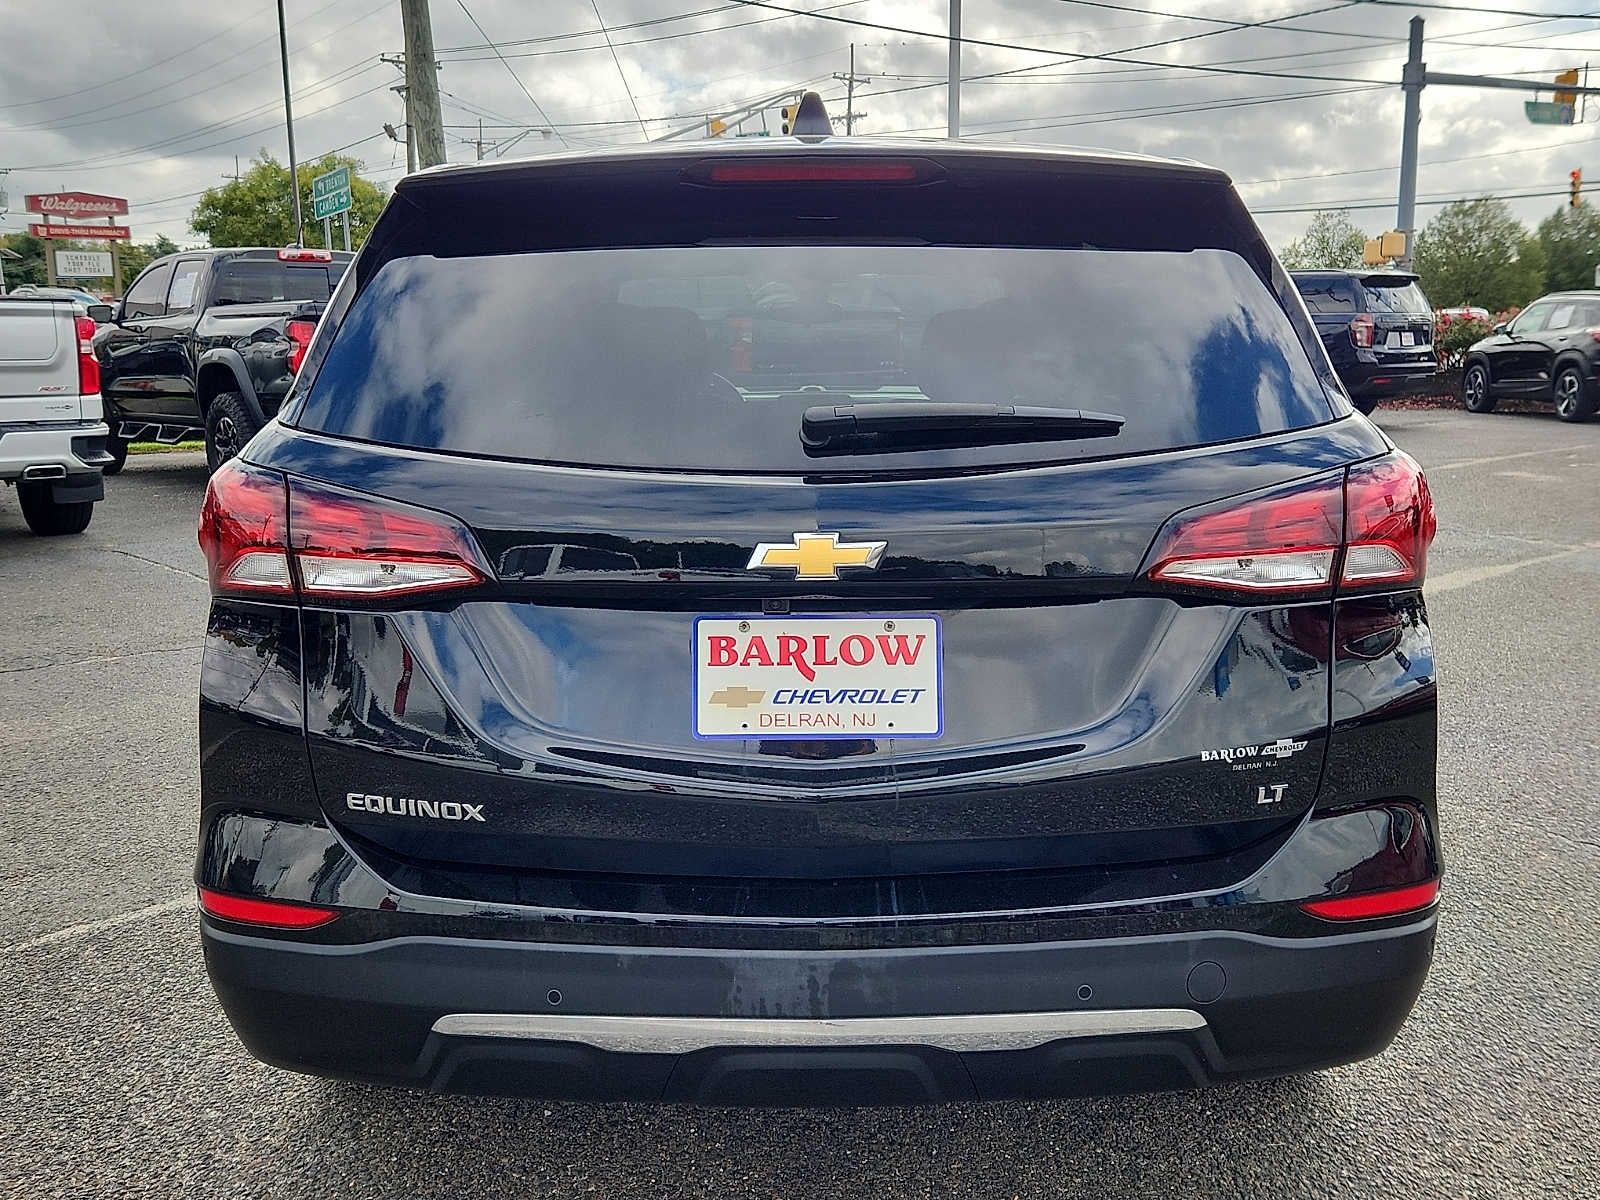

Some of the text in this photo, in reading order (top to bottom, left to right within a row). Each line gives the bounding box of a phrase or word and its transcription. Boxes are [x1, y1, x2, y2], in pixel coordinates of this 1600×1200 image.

[38, 196, 119, 214] Walgreens
[90, 229, 126, 237] PHARMACY
[707, 634, 926, 682] BARLOW
[772, 688, 926, 705] CHEVROLET
[759, 713, 877, 728] DELRAN, NJ
[1200, 743, 1305, 763] BARLOW CHEVROLET
[1232, 762, 1262, 771] DELRAN
[1257, 783, 1289, 804] LT
[346, 792, 487, 822] EQUINOX
